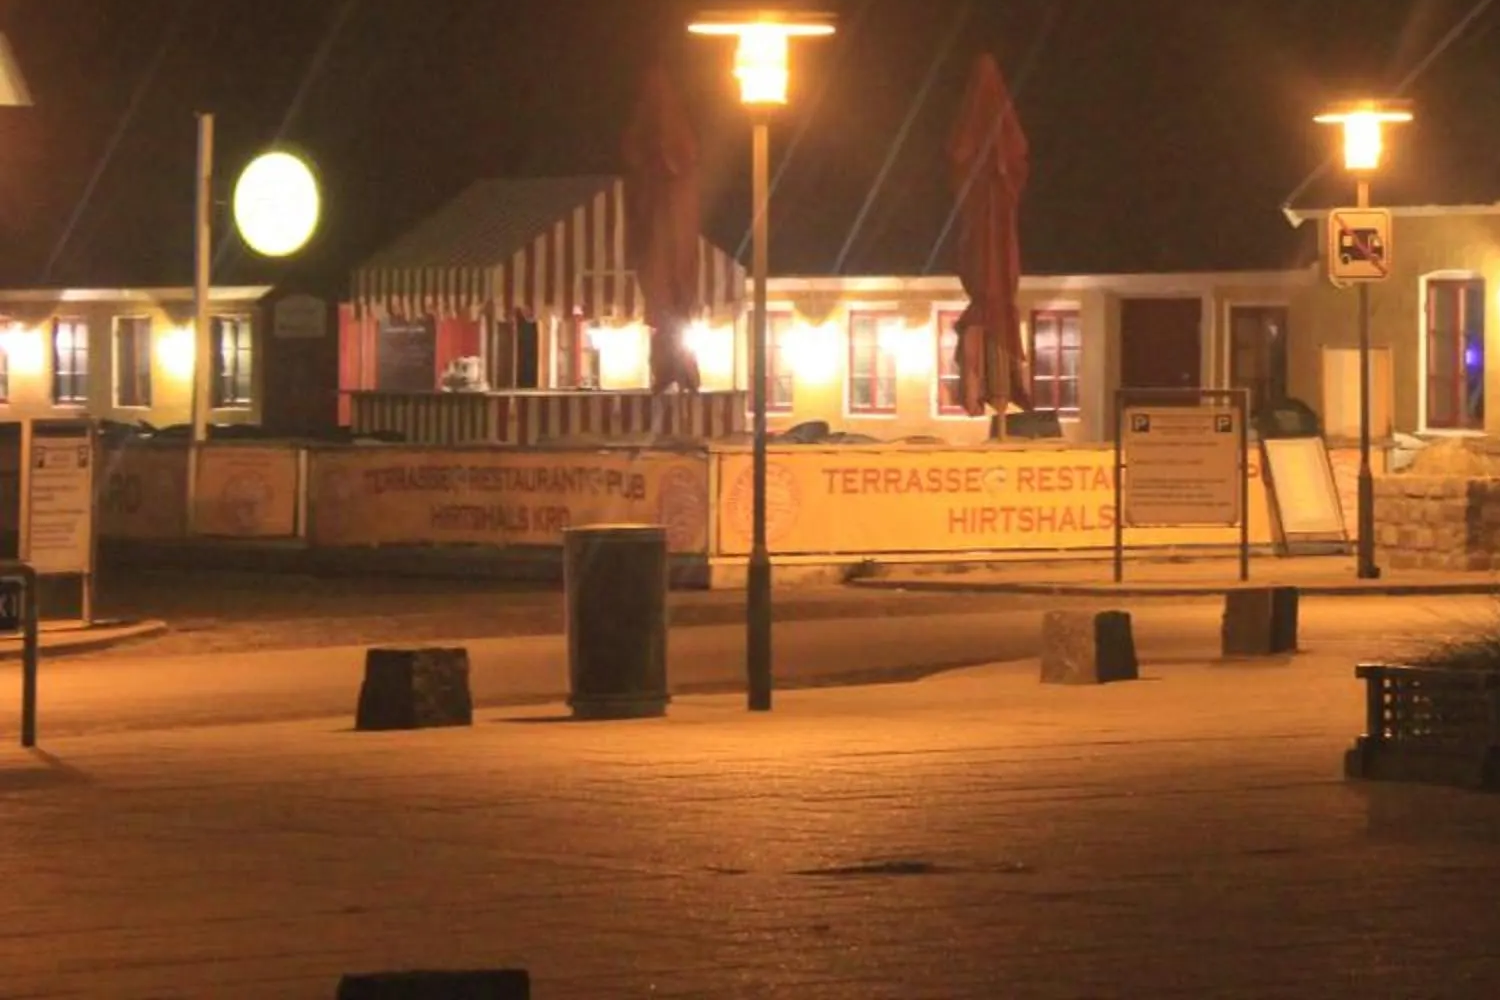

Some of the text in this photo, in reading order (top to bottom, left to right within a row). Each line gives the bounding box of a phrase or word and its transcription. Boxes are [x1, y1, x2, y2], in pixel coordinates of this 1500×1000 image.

[605, 468, 646, 499] PUB
[822, 467, 982, 494] TERRASSE
[948, 504, 1116, 534] HIRTSHALS
